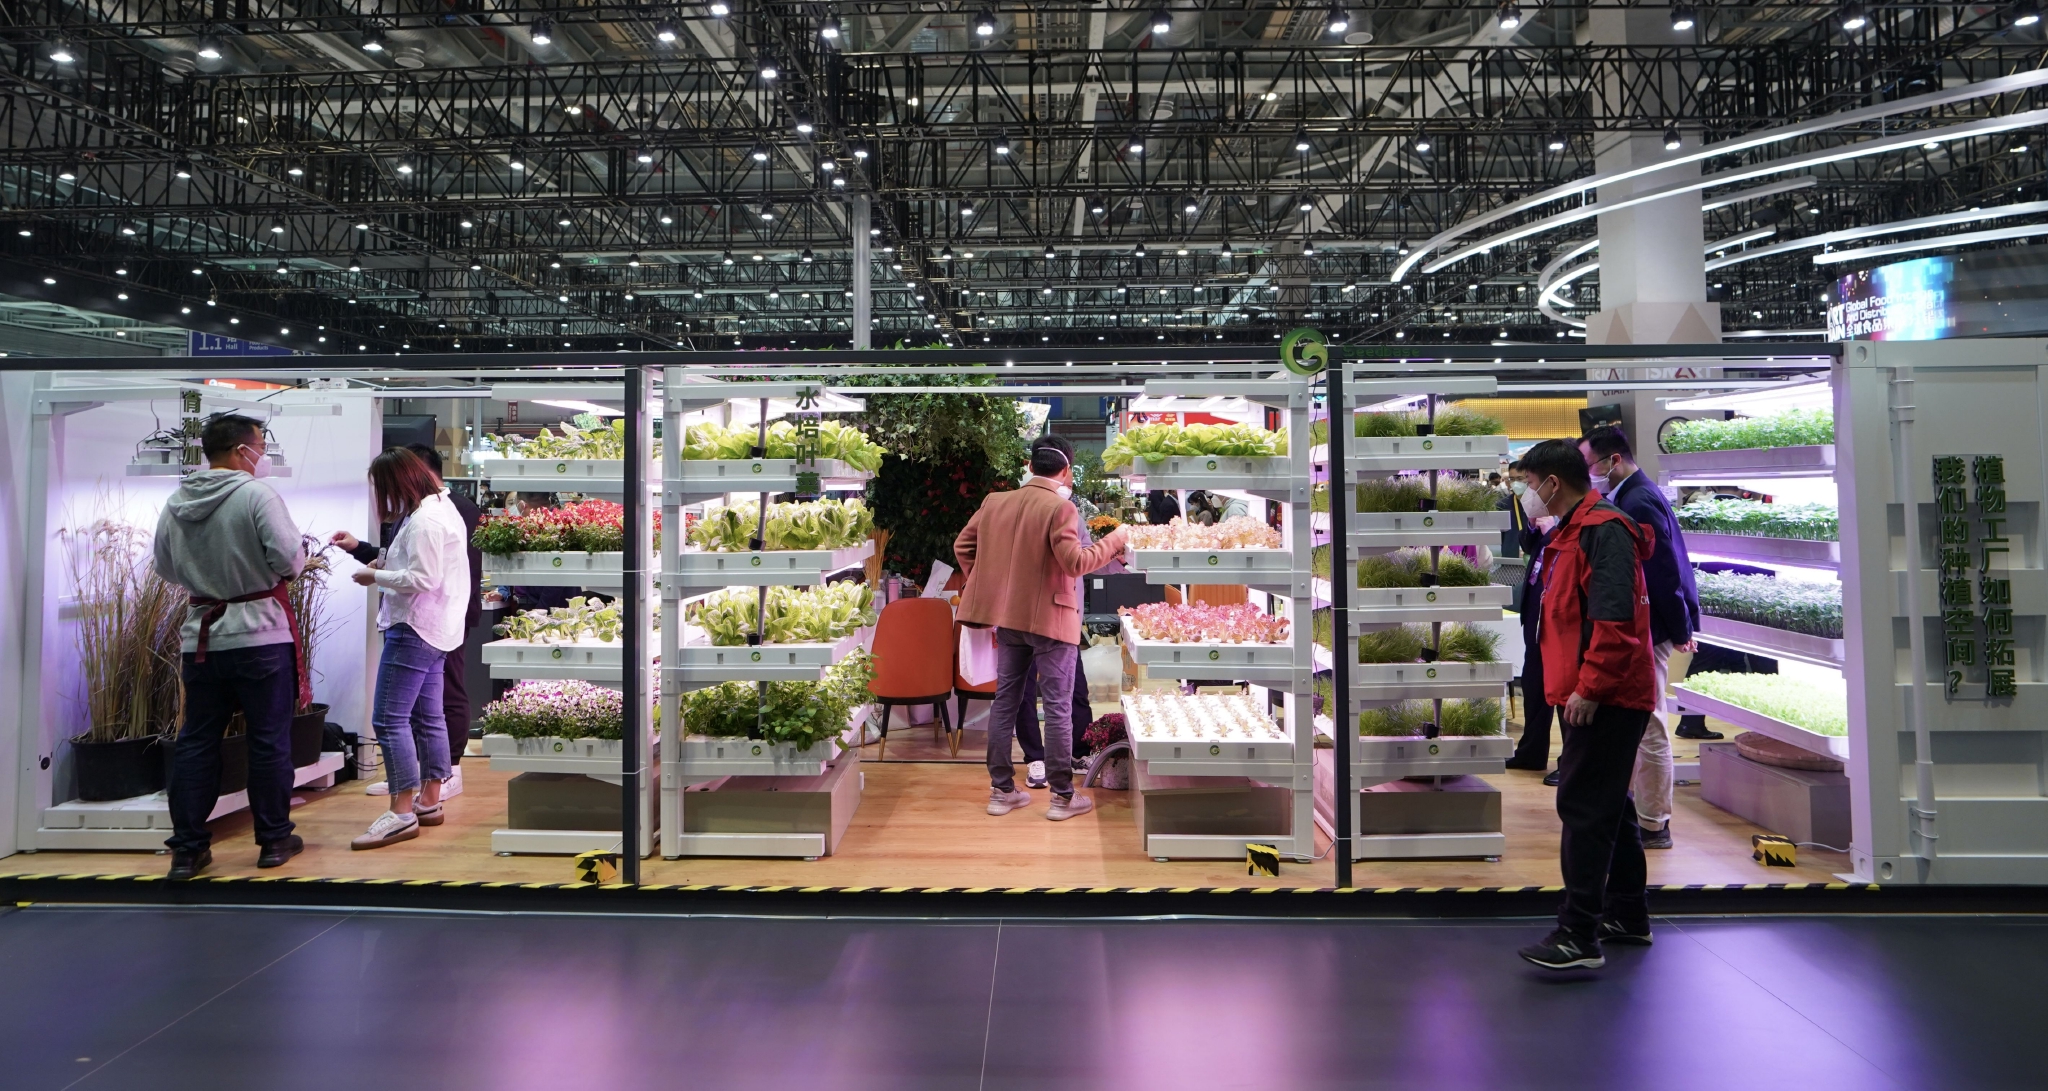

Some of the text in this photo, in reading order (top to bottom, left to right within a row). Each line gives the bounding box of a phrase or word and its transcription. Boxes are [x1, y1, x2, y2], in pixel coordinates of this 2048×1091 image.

[1845, 298, 1868, 313] Global
[1869, 295, 1893, 308] Food
[1846, 312, 1859, 323] And
[198, 332, 222, 351] 1.1
[1342, 344, 1420, 358] Seedbase
[182, 390, 203, 475] 育种加
[795, 386, 820, 495] 水培叶菜
[1934, 455, 1975, 695] 我们的种植空间？
[1975, 455, 2017, 698] 植物工厂如何拓展
